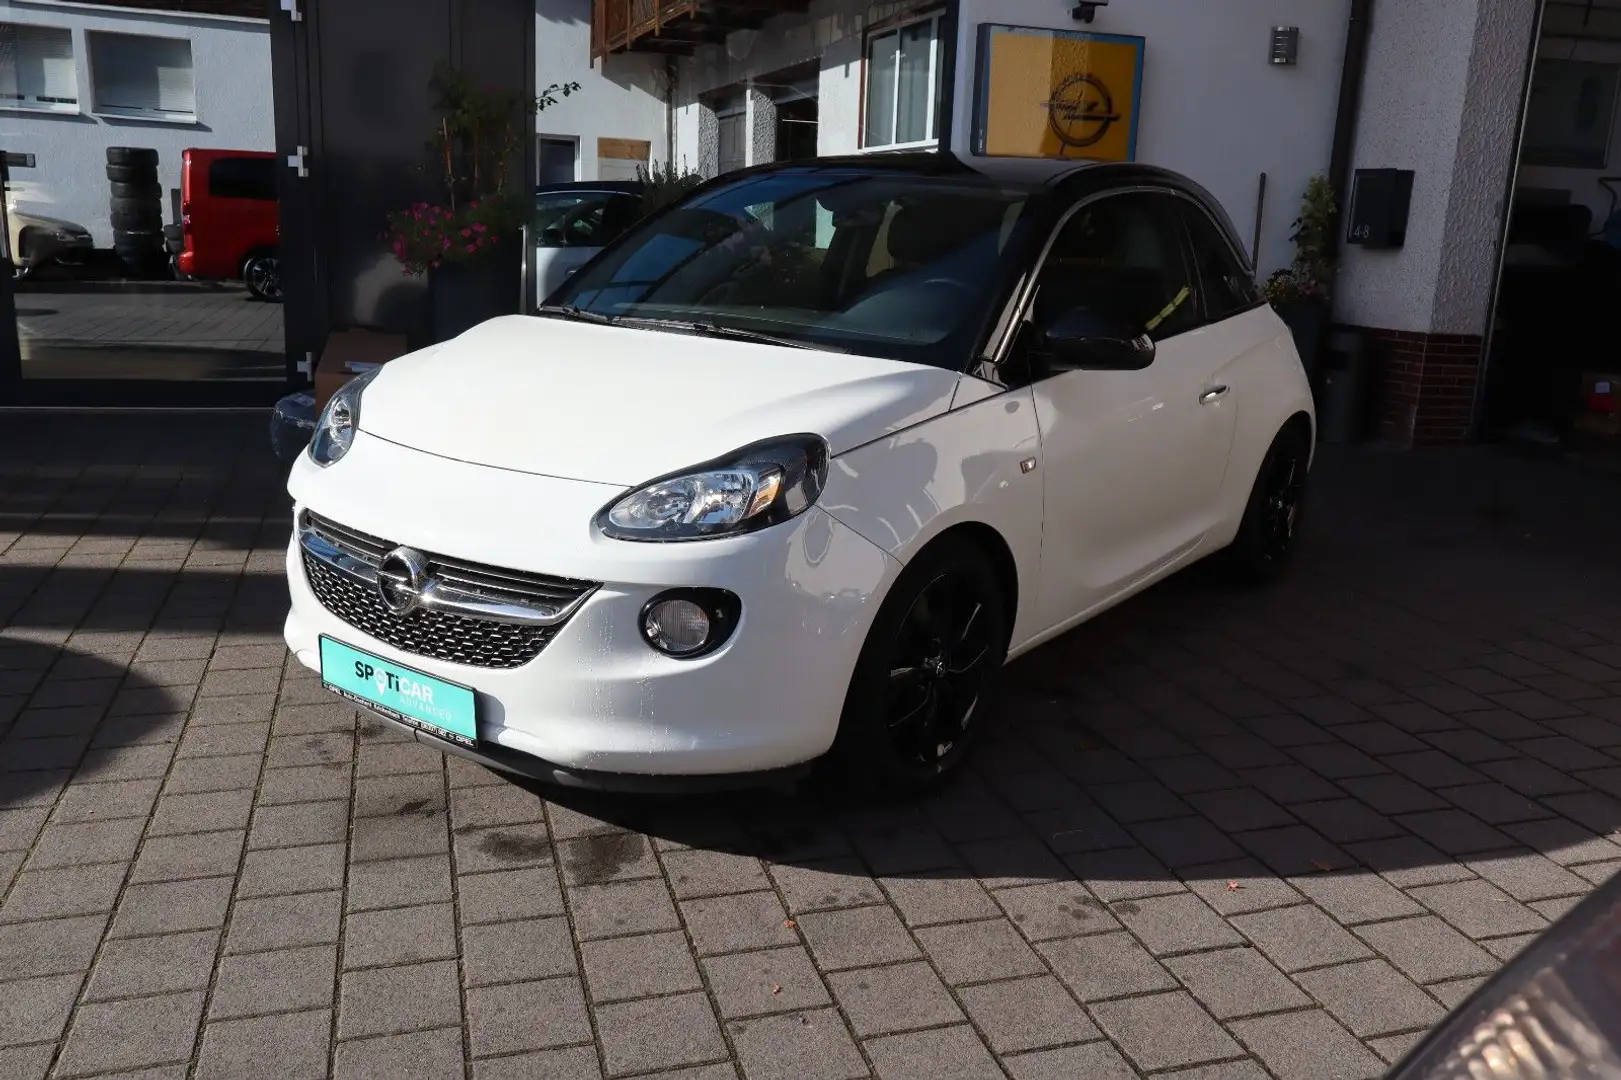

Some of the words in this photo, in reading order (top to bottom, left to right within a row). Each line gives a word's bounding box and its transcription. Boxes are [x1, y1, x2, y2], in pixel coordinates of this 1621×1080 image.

[328, 684, 342, 696] OPEL
[455, 734, 475, 746] OPEL
[400, 696, 452, 721] ADVANCED
